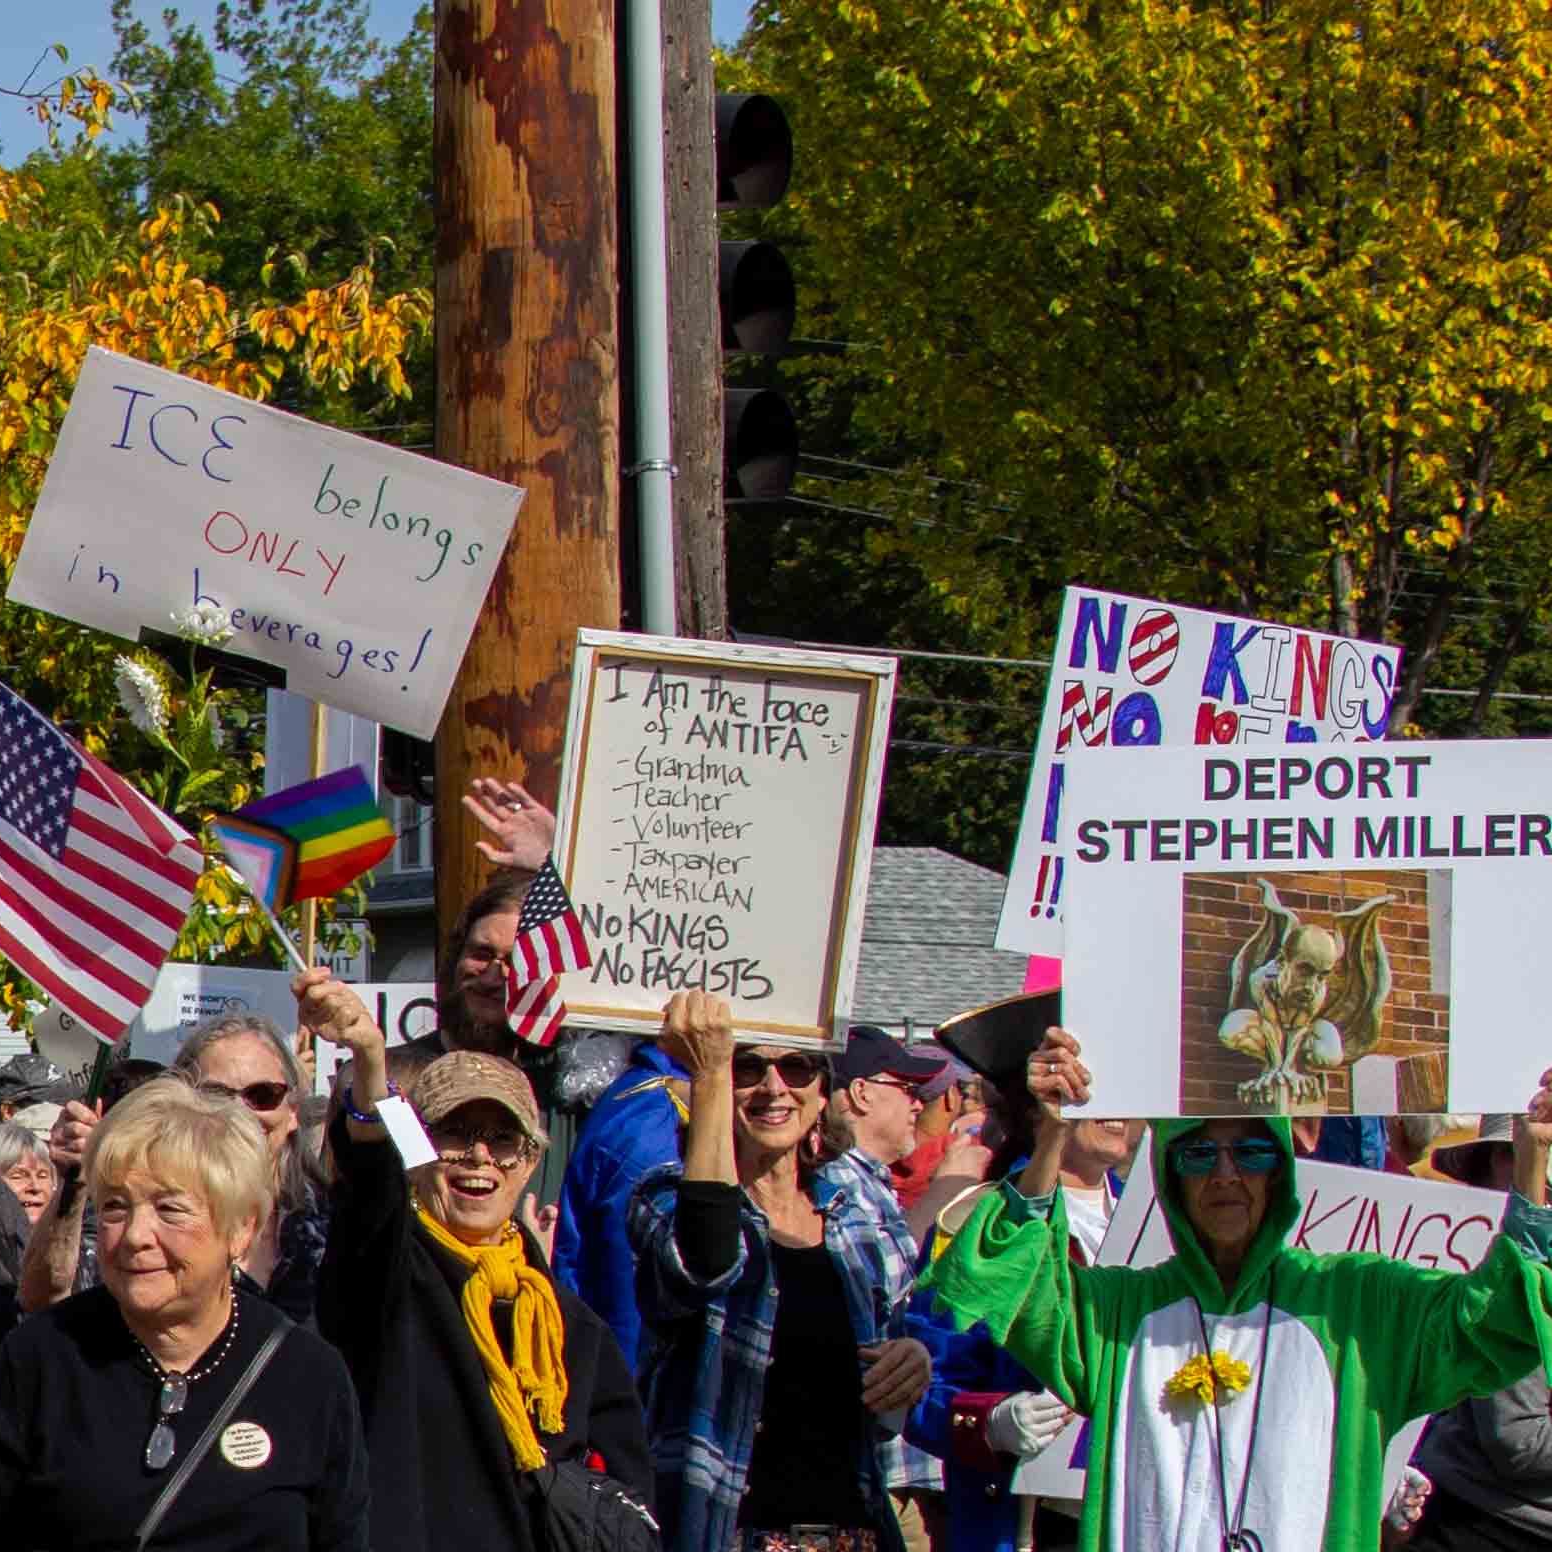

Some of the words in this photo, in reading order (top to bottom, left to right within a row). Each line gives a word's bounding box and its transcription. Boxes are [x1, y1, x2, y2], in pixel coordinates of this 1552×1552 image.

[110, 386, 247, 483] ICE
[313, 464, 484, 581] belongs
[67, 544, 119, 593] in
[204, 510, 347, 595] ONLY
[603, 662, 630, 703] I
[642, 668, 689, 709] Am
[701, 674, 748, 718] the
[1068, 597, 1180, 687] NO
[1201, 622, 1394, 741] KINGS
[644, 706, 677, 745] of
[684, 714, 808, 762] ANTIFA
[1056, 680, 1162, 752] NO
[1204, 756, 1431, 801] DEPORT
[632, 811, 753, 843] Volunteer
[1076, 817, 1334, 863] STEPHEN
[1354, 814, 1552, 859] MILLER
[623, 871, 753, 913] AMERICAN
[628, 903, 729, 955] KINGS
[591, 942, 634, 986] No
[641, 947, 774, 1000] FASCISTS
